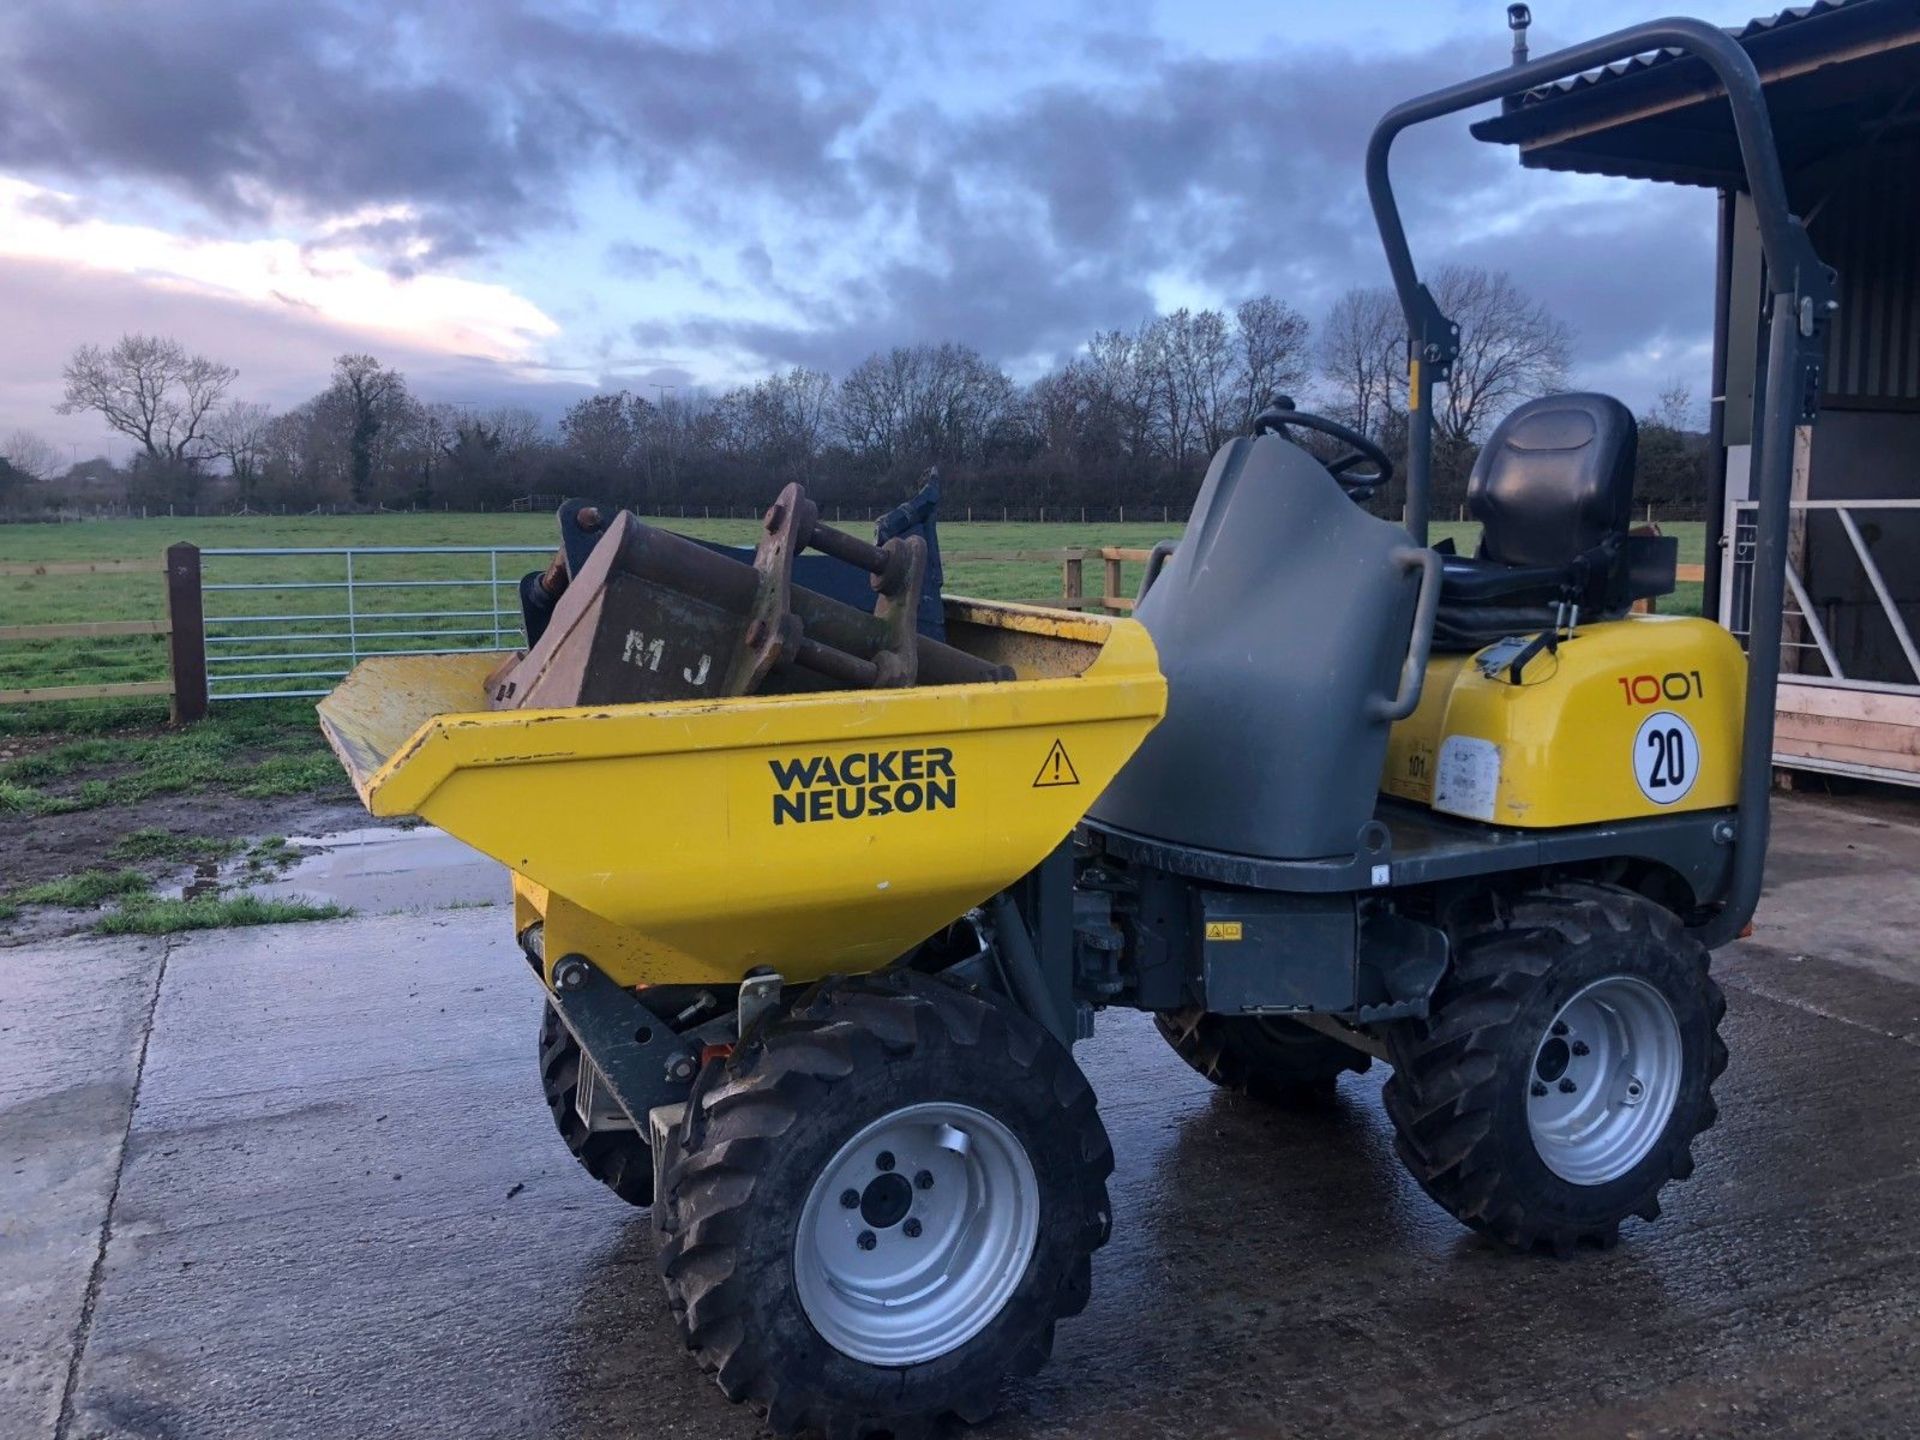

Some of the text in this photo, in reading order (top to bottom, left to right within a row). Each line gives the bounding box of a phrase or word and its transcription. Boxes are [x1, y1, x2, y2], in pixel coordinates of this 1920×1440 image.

[683, 654, 711, 685] J
[1618, 671, 1703, 706] 1001
[768, 748, 956, 791] WACKER
[1648, 728, 1685, 788] 20
[773, 779, 956, 825] NEUSON
